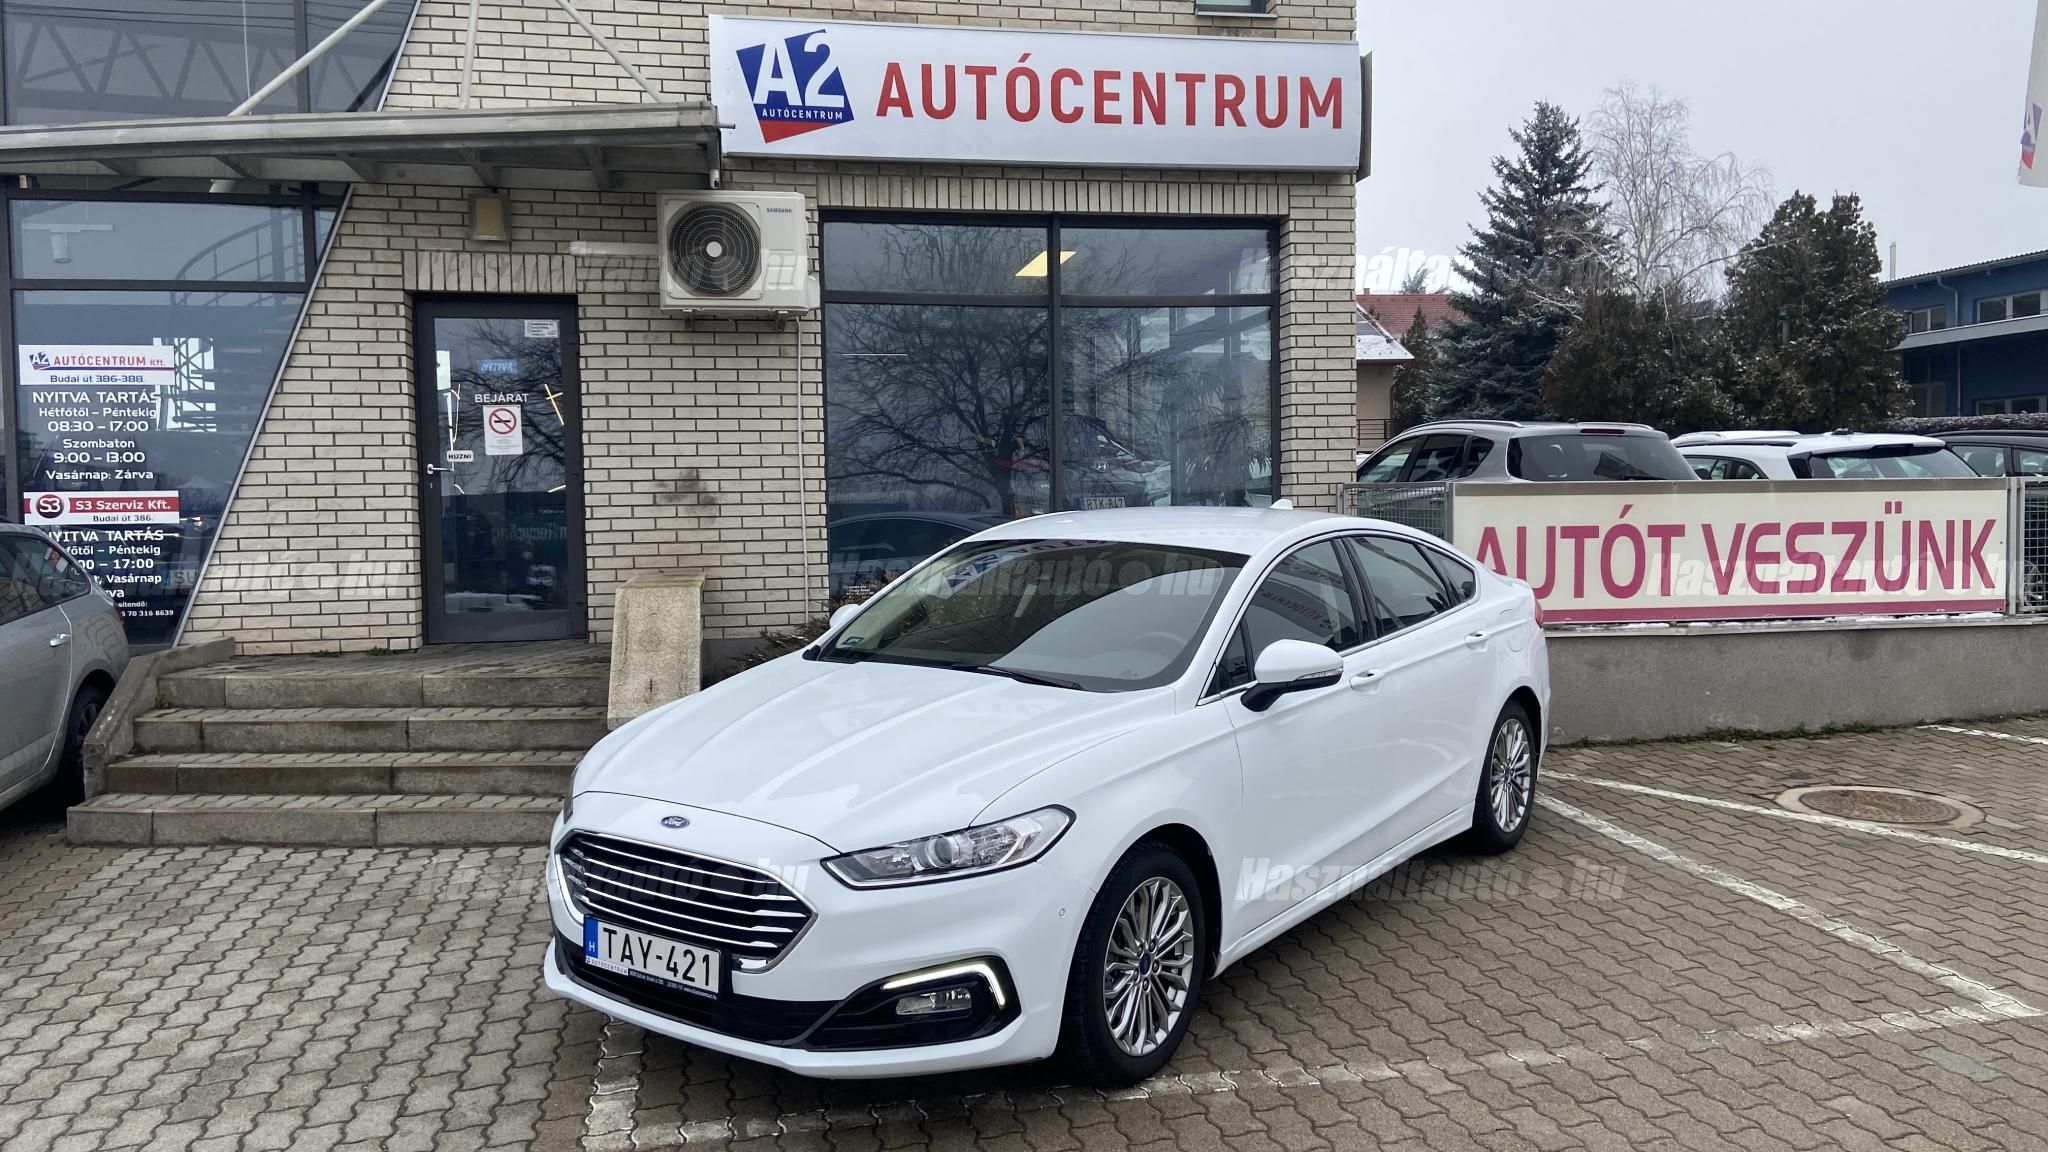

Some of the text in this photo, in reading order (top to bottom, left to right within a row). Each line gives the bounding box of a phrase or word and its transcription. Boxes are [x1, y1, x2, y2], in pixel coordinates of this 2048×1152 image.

[753, 32, 1343, 130] A2 AUTÓCENTRUM
[762, 107, 843, 120] AUTÓCENTRUM
[54, 352, 146, 366] AUTÓCENTRUM
[50, 375, 80, 383] Budai
[83, 375, 93, 383] út
[32, 388, 161, 404] NYITVA TARTÁS
[475, 392, 530, 403] BEJÁRAT
[39, 407, 89, 418] Hétfőtől
[103, 407, 158, 420] Péntekig
[48, 421, 94, 432] 08:30
[110, 421, 149, 432] 17:00
[63, 438, 135, 449] Szombaton
[54, 452, 91, 463] 9:00
[106, 452, 146, 463] 13:00
[46, 469, 154, 482] Vasárnap: Zárva
[39, 497, 61, 513] S3
[76, 500, 171, 510] S3 Szerviz Kft.
[122, 514, 132, 522] út
[105, 527, 164, 541] TARTÁS
[109, 545, 161, 556] Péntekig
[1475, 500, 1997, 600] AUTÓT VESZÜNK
[113, 558, 154, 569] 17:00
[106, 574, 162, 585] Vasárnap
[588, 940, 596, 953] H
[603, 927, 711, 987] TAY-421
